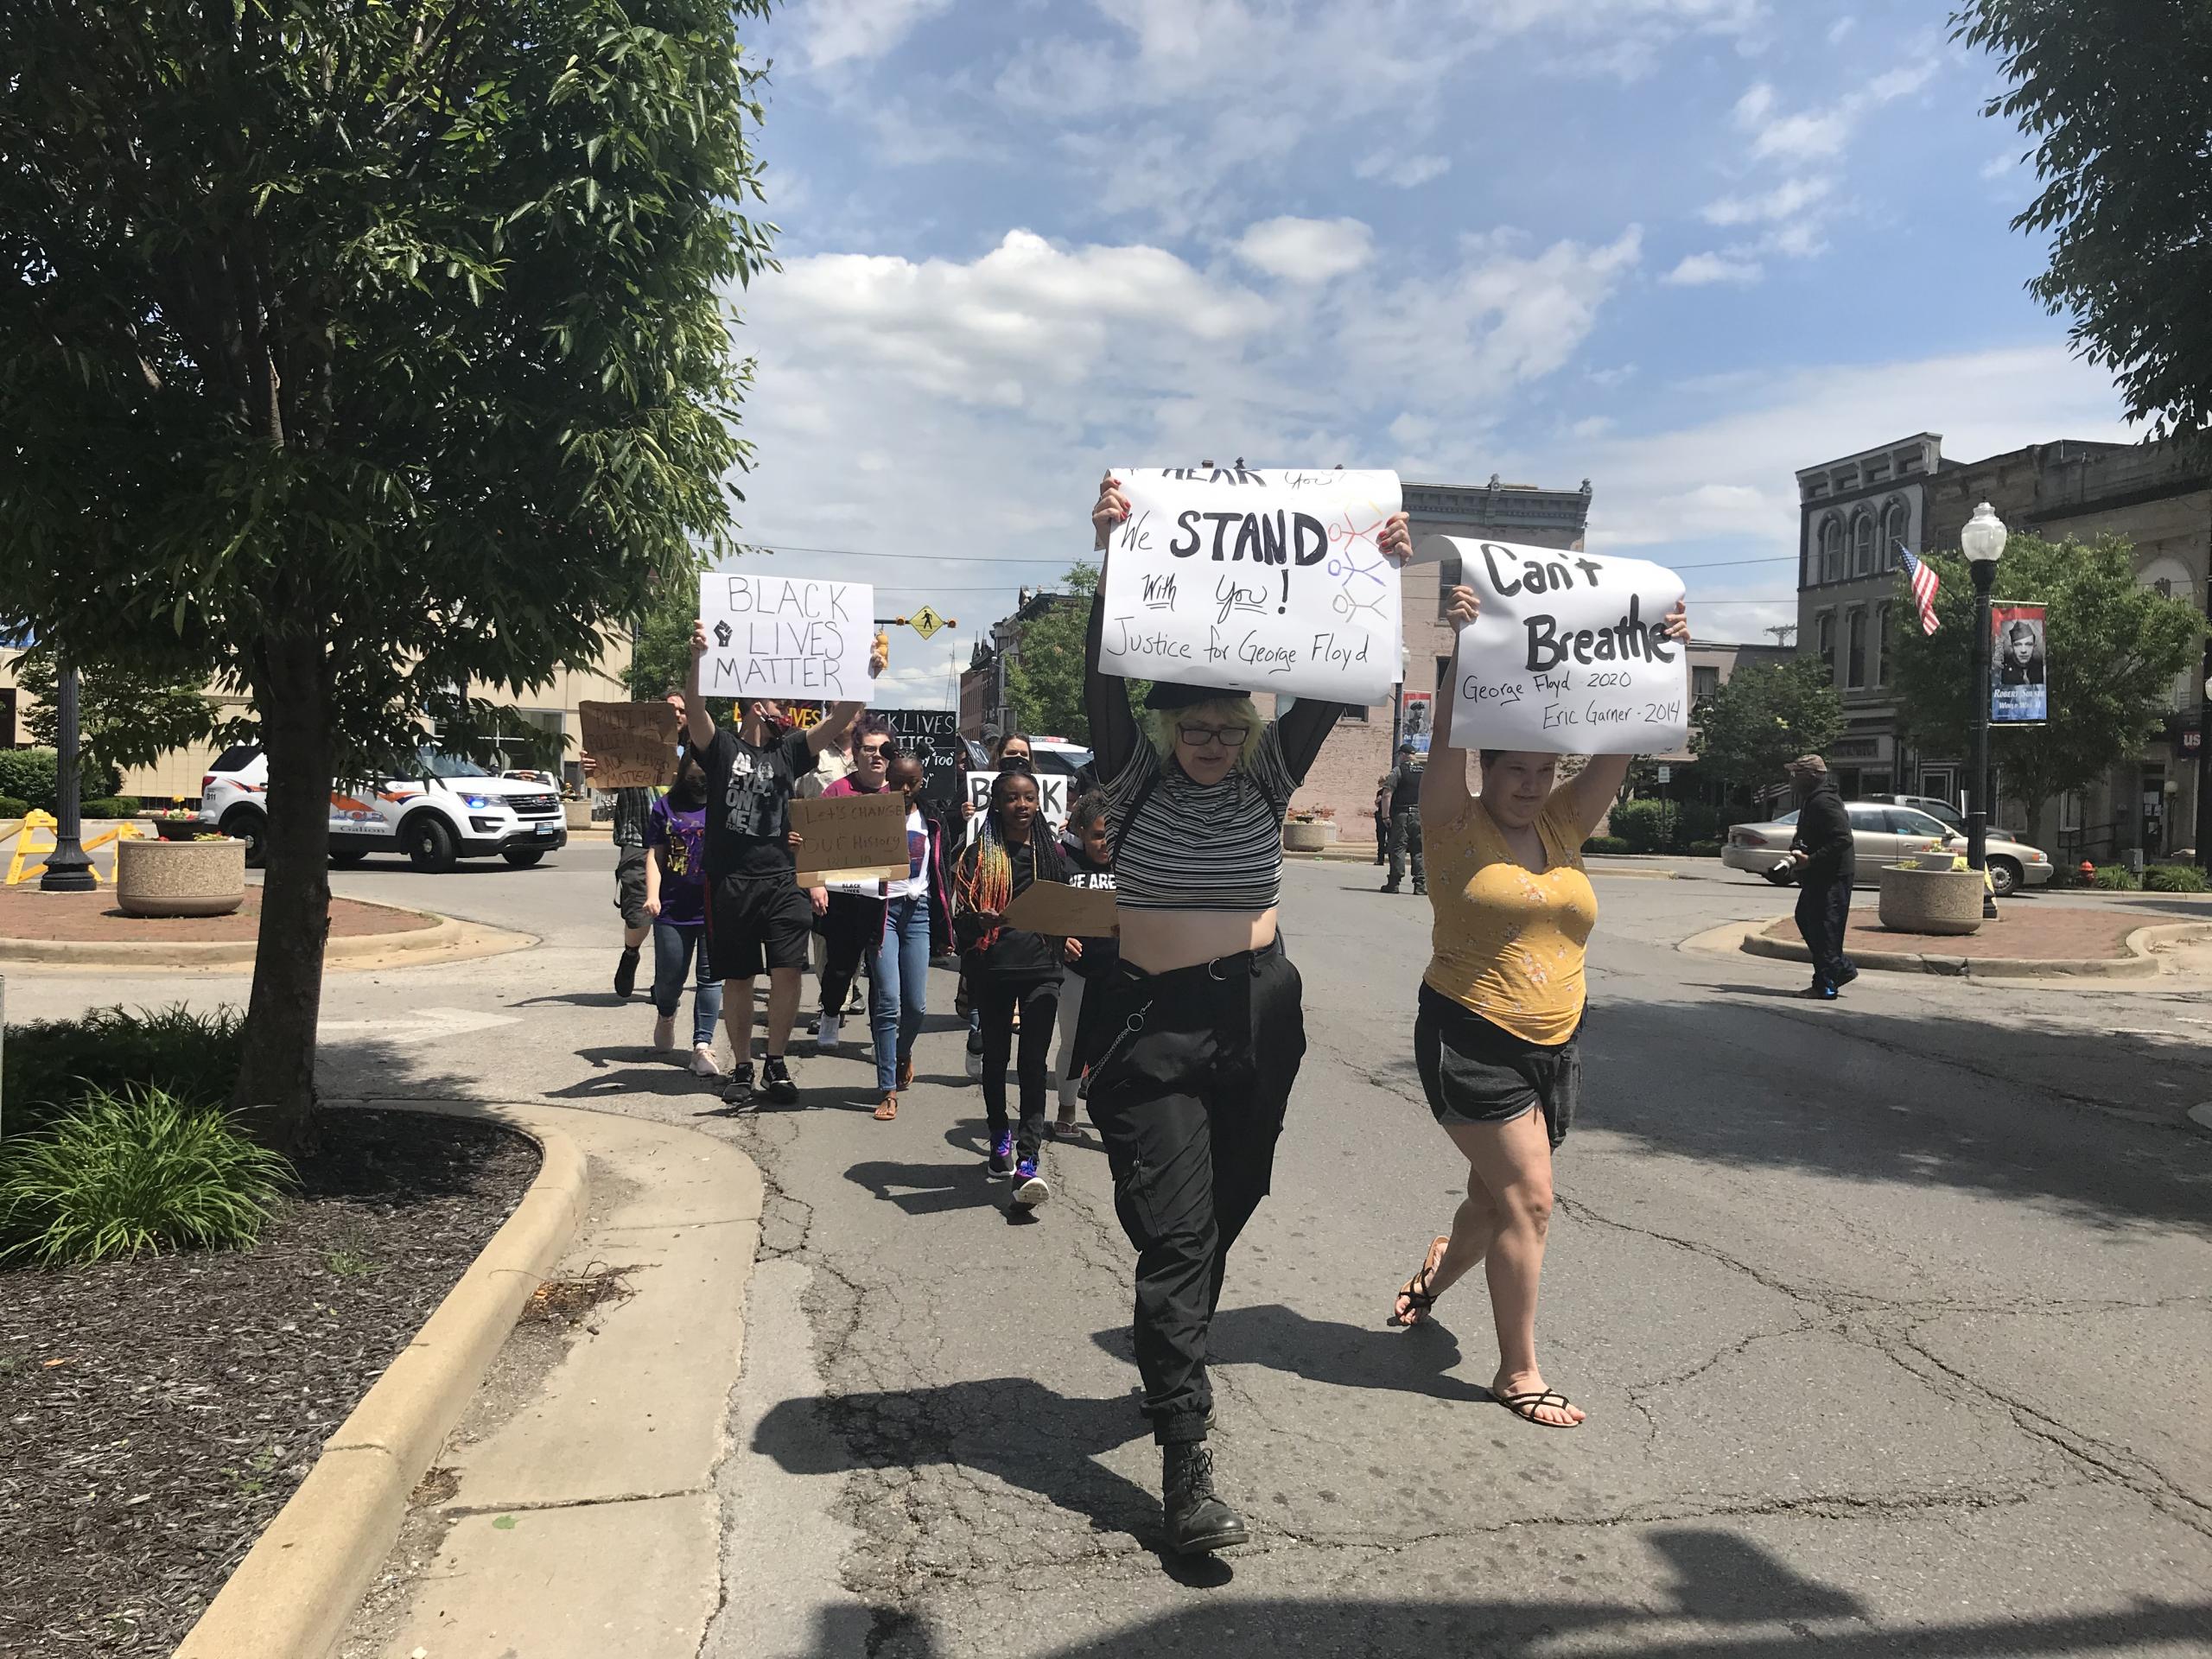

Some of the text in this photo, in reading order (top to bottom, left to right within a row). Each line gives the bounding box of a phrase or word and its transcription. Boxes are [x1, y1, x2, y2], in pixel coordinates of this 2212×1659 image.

[1121, 509, 1328, 566] We STAND
[1480, 543, 1604, 597] Can't
[728, 576, 849, 622] BLACK
[1141, 573, 1177, 612] With
[749, 620, 844, 660] LIVES
[1106, 616, 1370, 674] Justice for George Floyd
[1522, 593, 1676, 672] Breathe
[715, 657, 843, 696] MATTER
[1463, 671, 1631, 706] George Floyd 2020
[902, 713, 954, 734] LIVES
[1542, 703, 1579, 729] Eric
[1586, 700, 1632, 723] Garner
[340, 825, 385, 834] Galion
[851, 804, 902, 820] CHANGE
[1089, 873, 1116, 890] ARE
